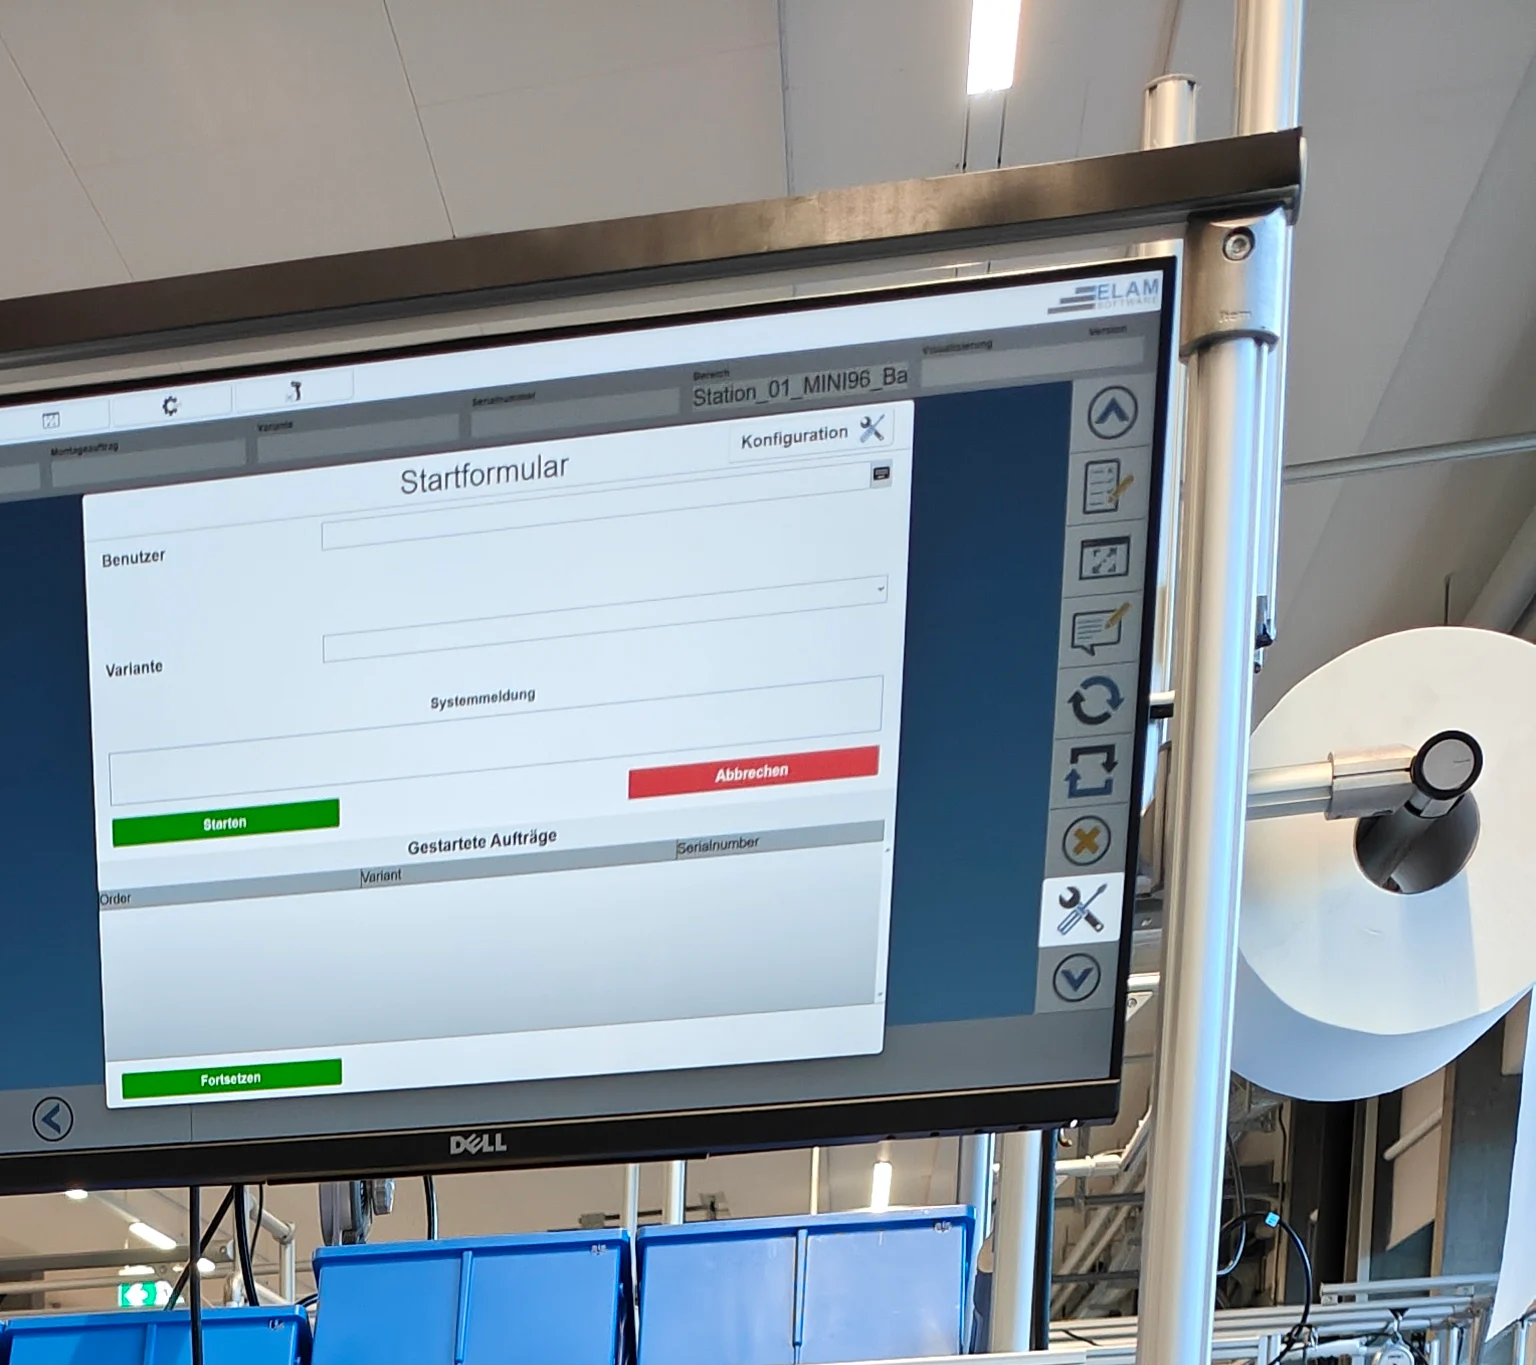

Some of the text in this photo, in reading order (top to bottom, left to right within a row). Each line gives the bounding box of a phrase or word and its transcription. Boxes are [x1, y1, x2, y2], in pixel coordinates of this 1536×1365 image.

[1098, 278, 1159, 300] ELAM
[692, 366, 909, 409] Station_01_MINI96_Ba
[741, 425, 849, 450] Konfiguration
[400, 453, 570, 496] Startformular
[101, 548, 166, 568] Benutzer
[105, 658, 163, 677] Variante
[430, 687, 536, 711] Systemmeldung
[715, 762, 789, 783] Abbrechen
[202, 815, 247, 832] Starten
[407, 827, 558, 856] Gestartete Aufträge
[677, 835, 760, 856] Serialnumber
[362, 867, 402, 884] Variant
[99, 892, 132, 907] Order
[200, 1071, 261, 1087] Fortsetzen
[450, 1133, 507, 1156] DELL
